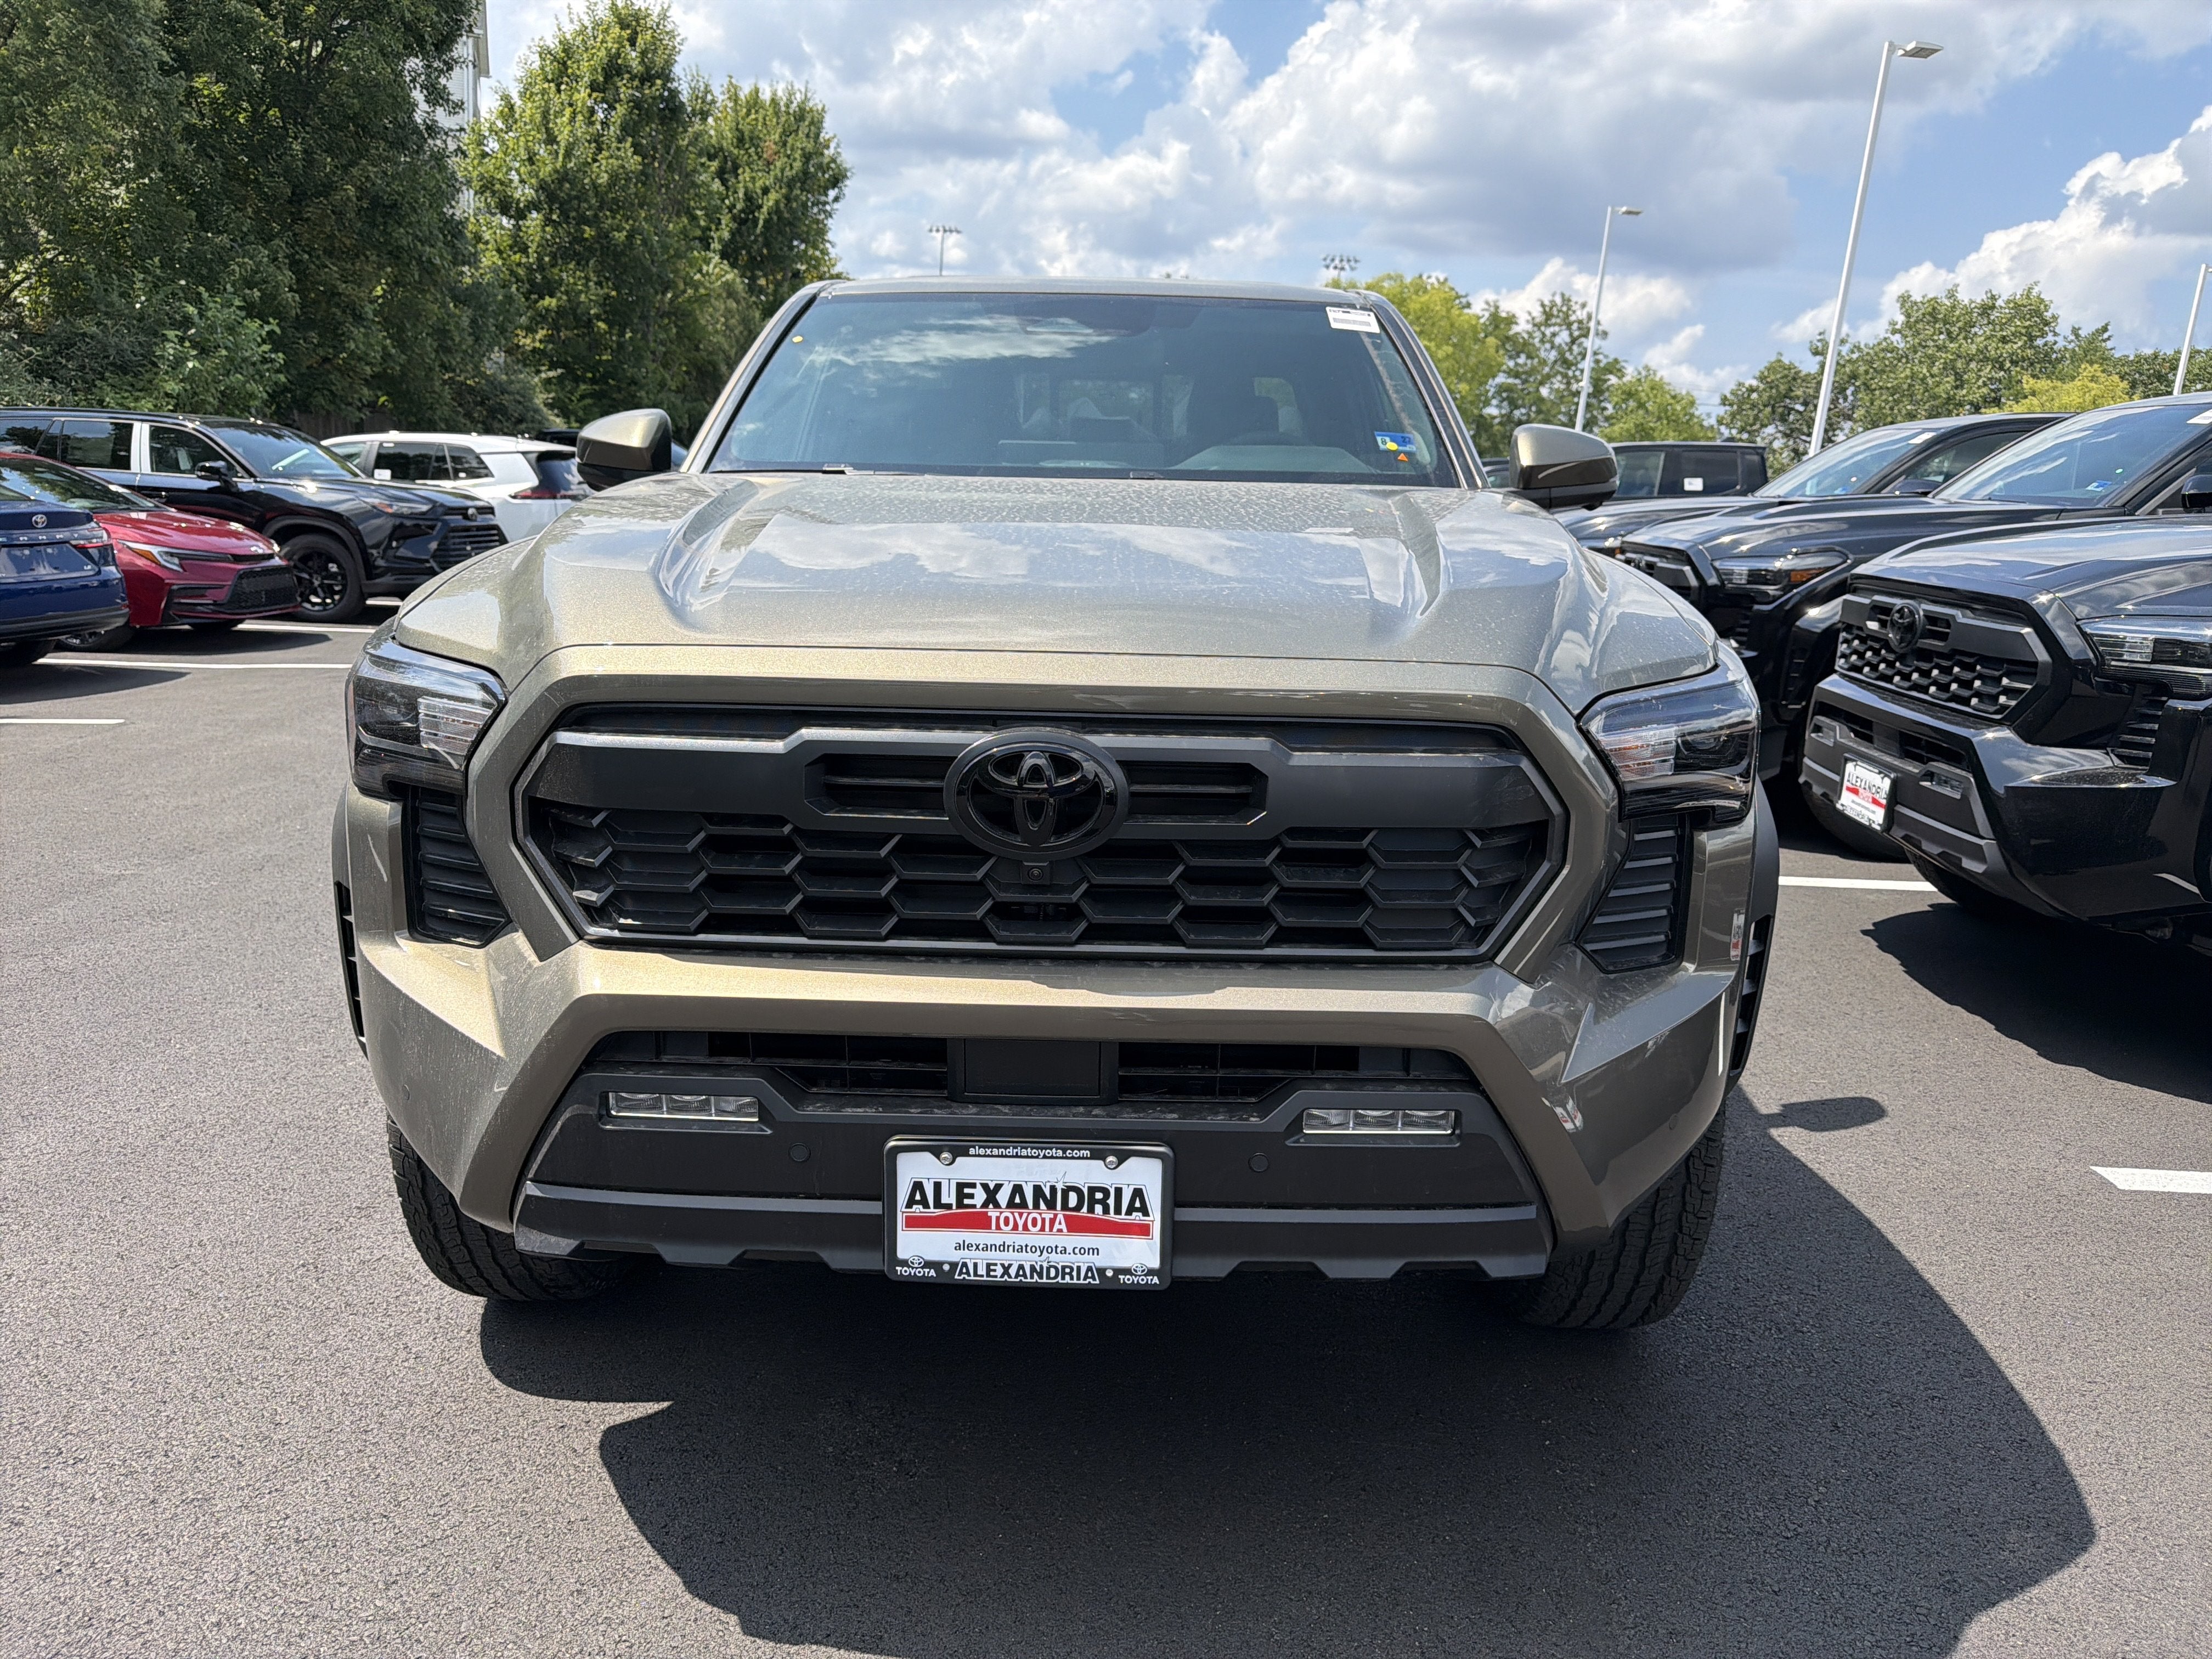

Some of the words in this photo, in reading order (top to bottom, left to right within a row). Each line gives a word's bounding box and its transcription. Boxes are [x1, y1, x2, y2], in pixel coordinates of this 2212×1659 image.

[969, 1146, 1090, 1159] alexandriatoyota.com
[904, 1180, 1151, 1218] ALEXANDRIA
[988, 1211, 1068, 1233] TOYOTA
[954, 1239, 1100, 1257] alexandriatoyota.com
[895, 1266, 936, 1278] TOYOTA
[955, 1260, 1099, 1284] ALEXANDRIA
[1118, 1274, 1160, 1285] TOYOTA
